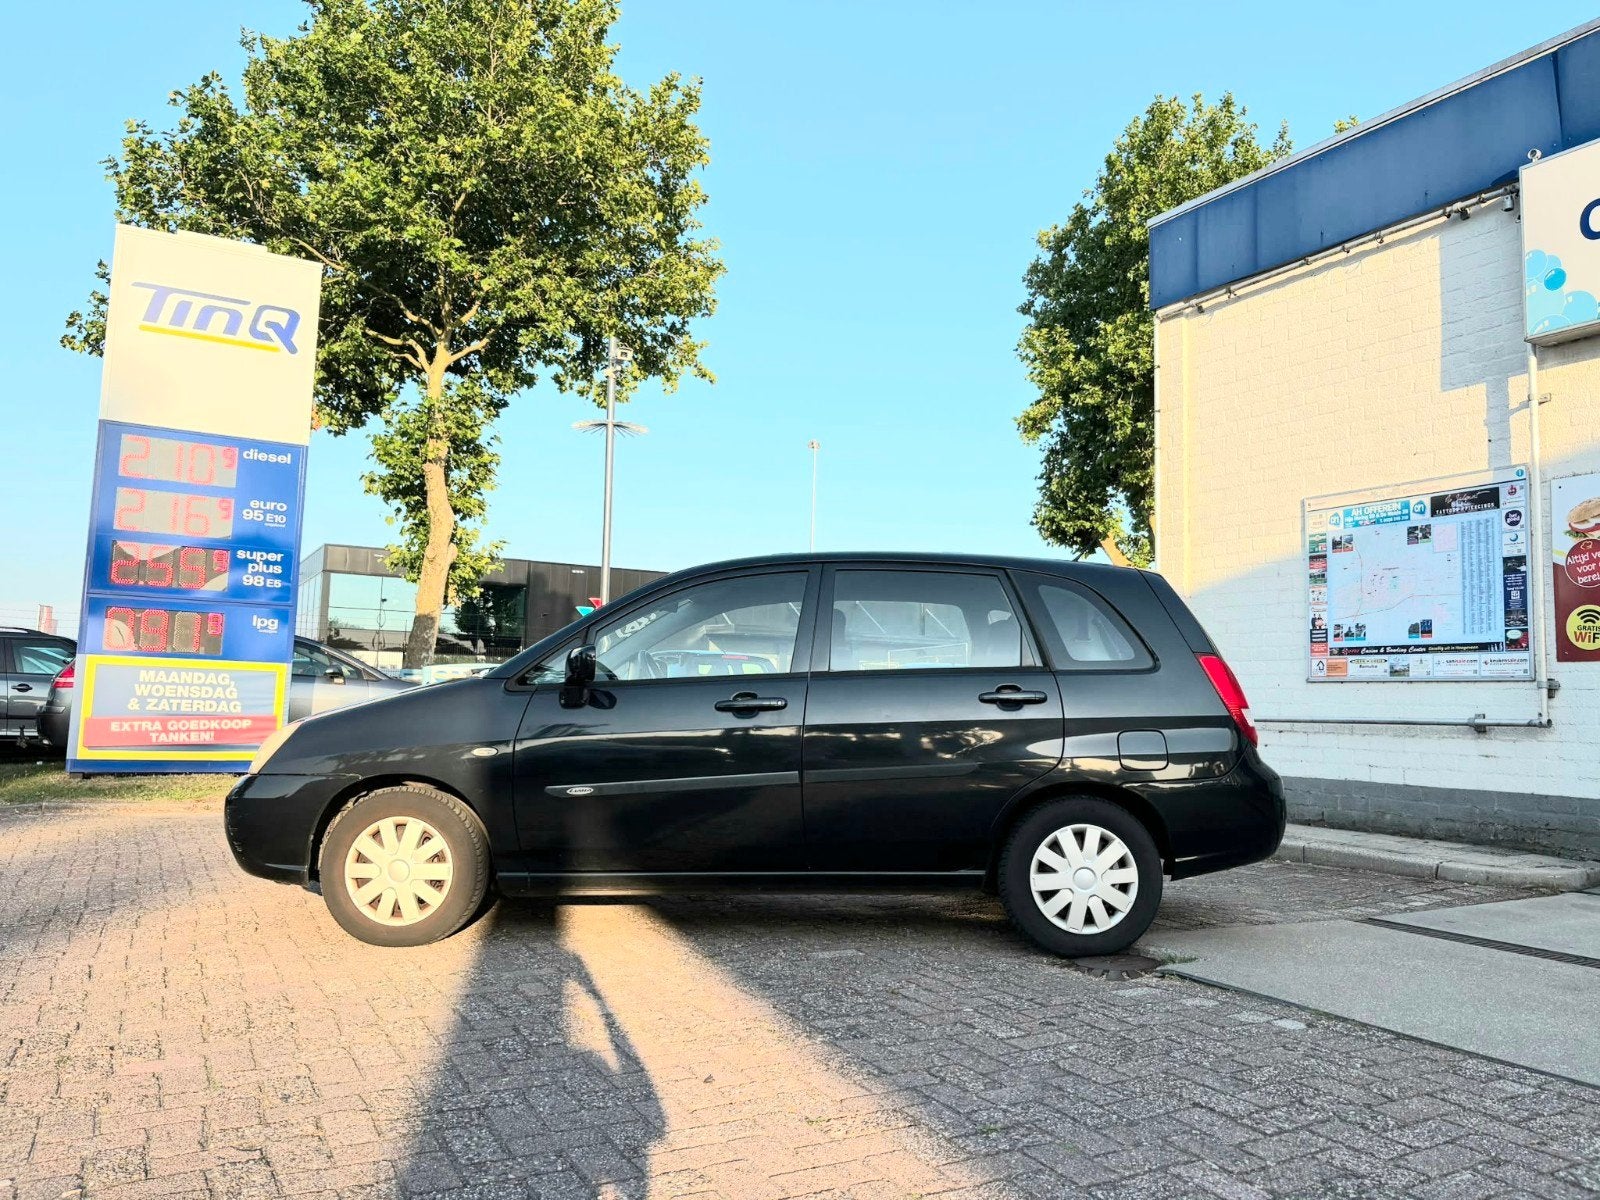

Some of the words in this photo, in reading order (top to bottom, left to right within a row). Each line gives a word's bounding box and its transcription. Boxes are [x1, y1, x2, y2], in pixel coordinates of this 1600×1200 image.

[242, 448, 292, 464] diesel
[250, 500, 288, 512] euro
[242, 508, 264, 522] 95
[266, 513, 286, 524] E10
[236, 549, 284, 562] super
[1567, 552, 1590, 565] Altijd
[248, 561, 282, 574] plus
[1577, 562, 1597, 573] voor
[242, 575, 265, 587] 98
[266, 578, 282, 588] E5
[252, 614, 278, 630] lpg
[140, 669, 236, 687] MAANDAG,
[135, 682, 238, 699] WOENSDAG
[128, 698, 140, 710] &
[146, 698, 242, 713] ZATERDAG
[110, 720, 160, 732] EXTRA
[167, 718, 252, 730] GOEDKOOP
[150, 731, 215, 742] TANKEN!
